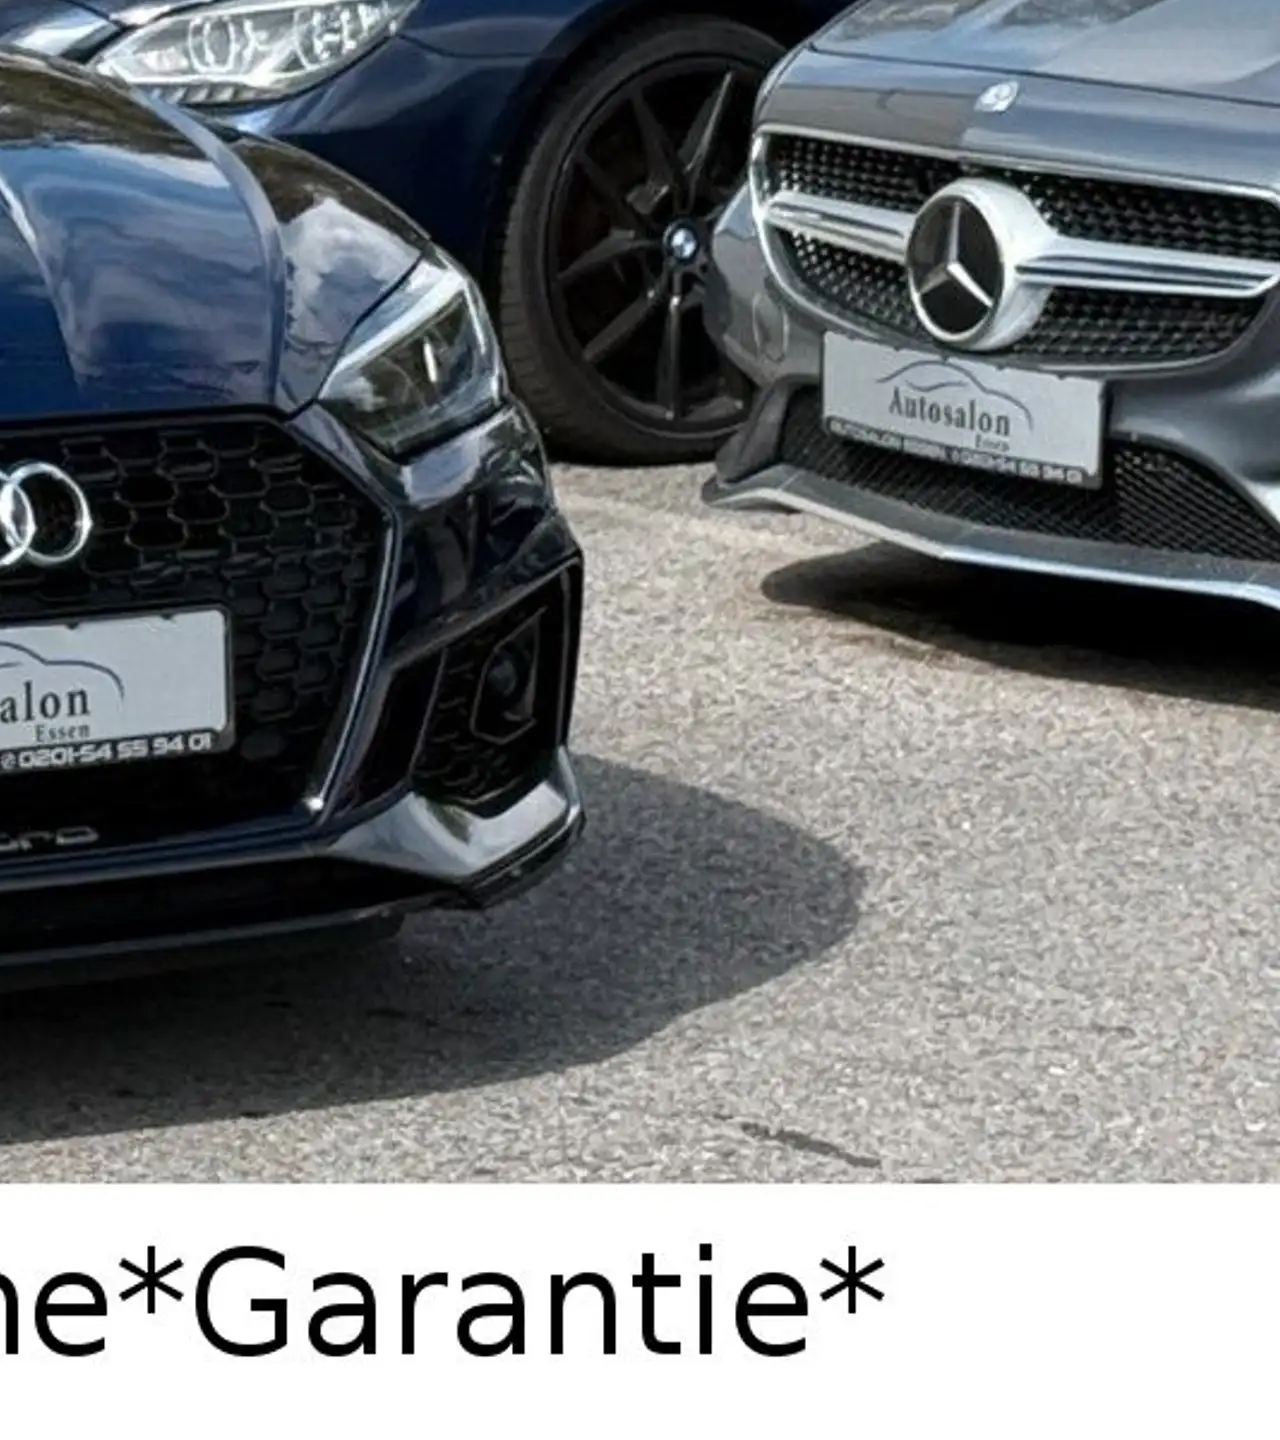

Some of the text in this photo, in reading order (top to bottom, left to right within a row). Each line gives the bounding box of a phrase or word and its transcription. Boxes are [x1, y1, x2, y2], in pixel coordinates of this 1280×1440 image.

[888, 384, 1011, 438] Autosalon
[34, 723, 91, 743] Essen
[152, 734, 185, 756] 94
[188, 731, 213, 751] 01
